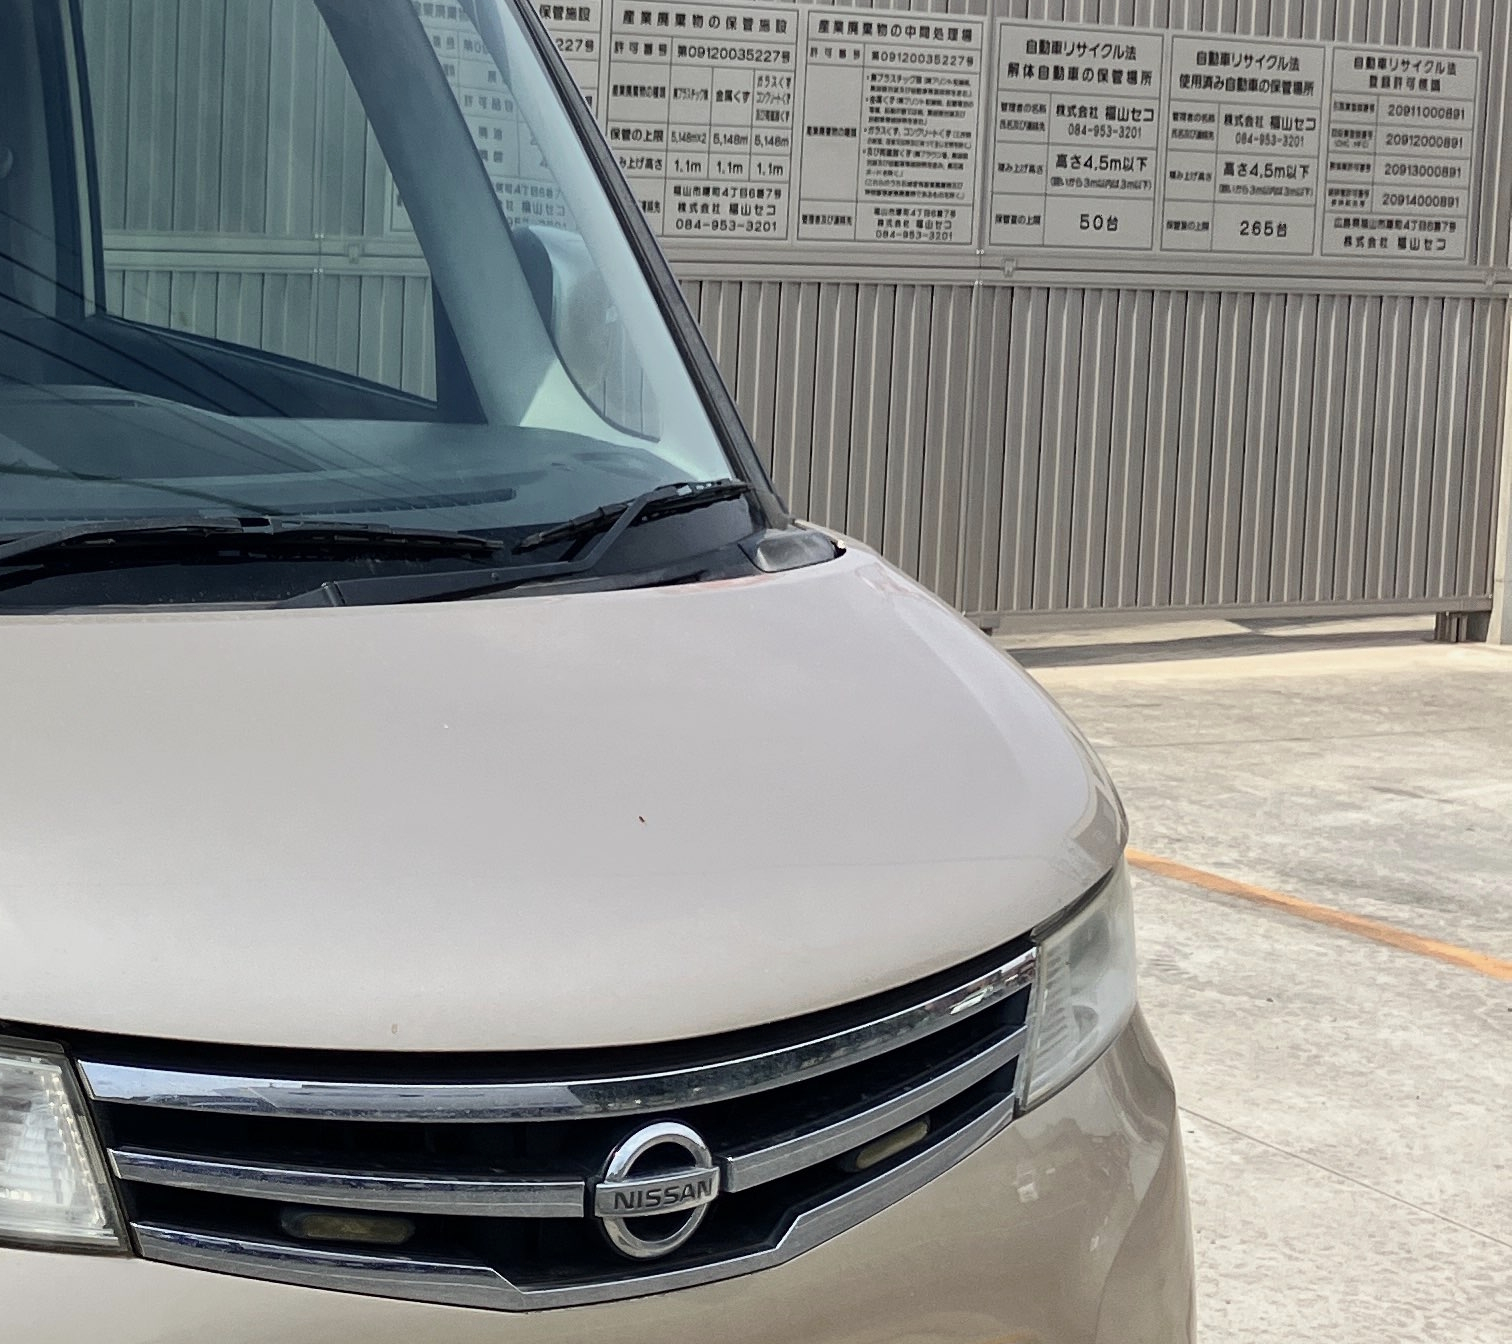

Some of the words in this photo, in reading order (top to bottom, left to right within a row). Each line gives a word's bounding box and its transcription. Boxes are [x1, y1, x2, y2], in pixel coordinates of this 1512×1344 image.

[1025, 38, 1137, 61] 自動車リサイクル法
[1196, 50, 1301, 72] 自動車リサイクル法
[613, 1177, 713, 1210] NISSAN
